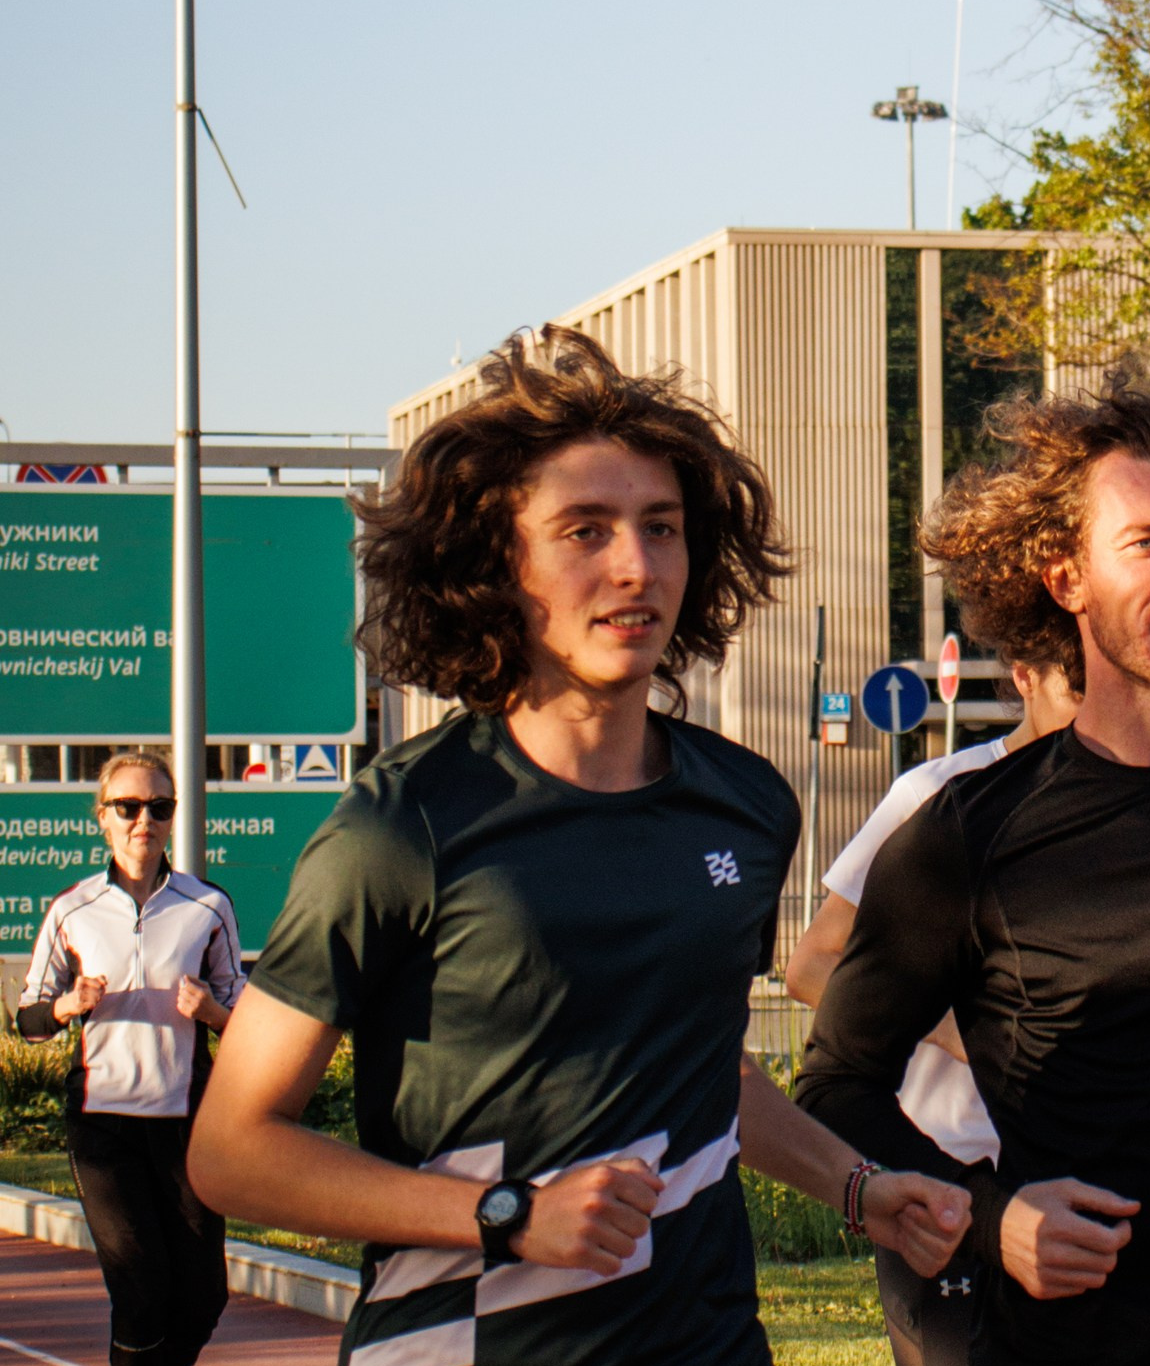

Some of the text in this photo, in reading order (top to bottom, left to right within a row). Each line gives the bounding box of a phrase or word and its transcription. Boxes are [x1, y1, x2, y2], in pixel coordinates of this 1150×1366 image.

[34, 552, 100, 571] Street
[0, 656, 141, 681] vnicheskij Val
[828, 697, 845, 711] 24
